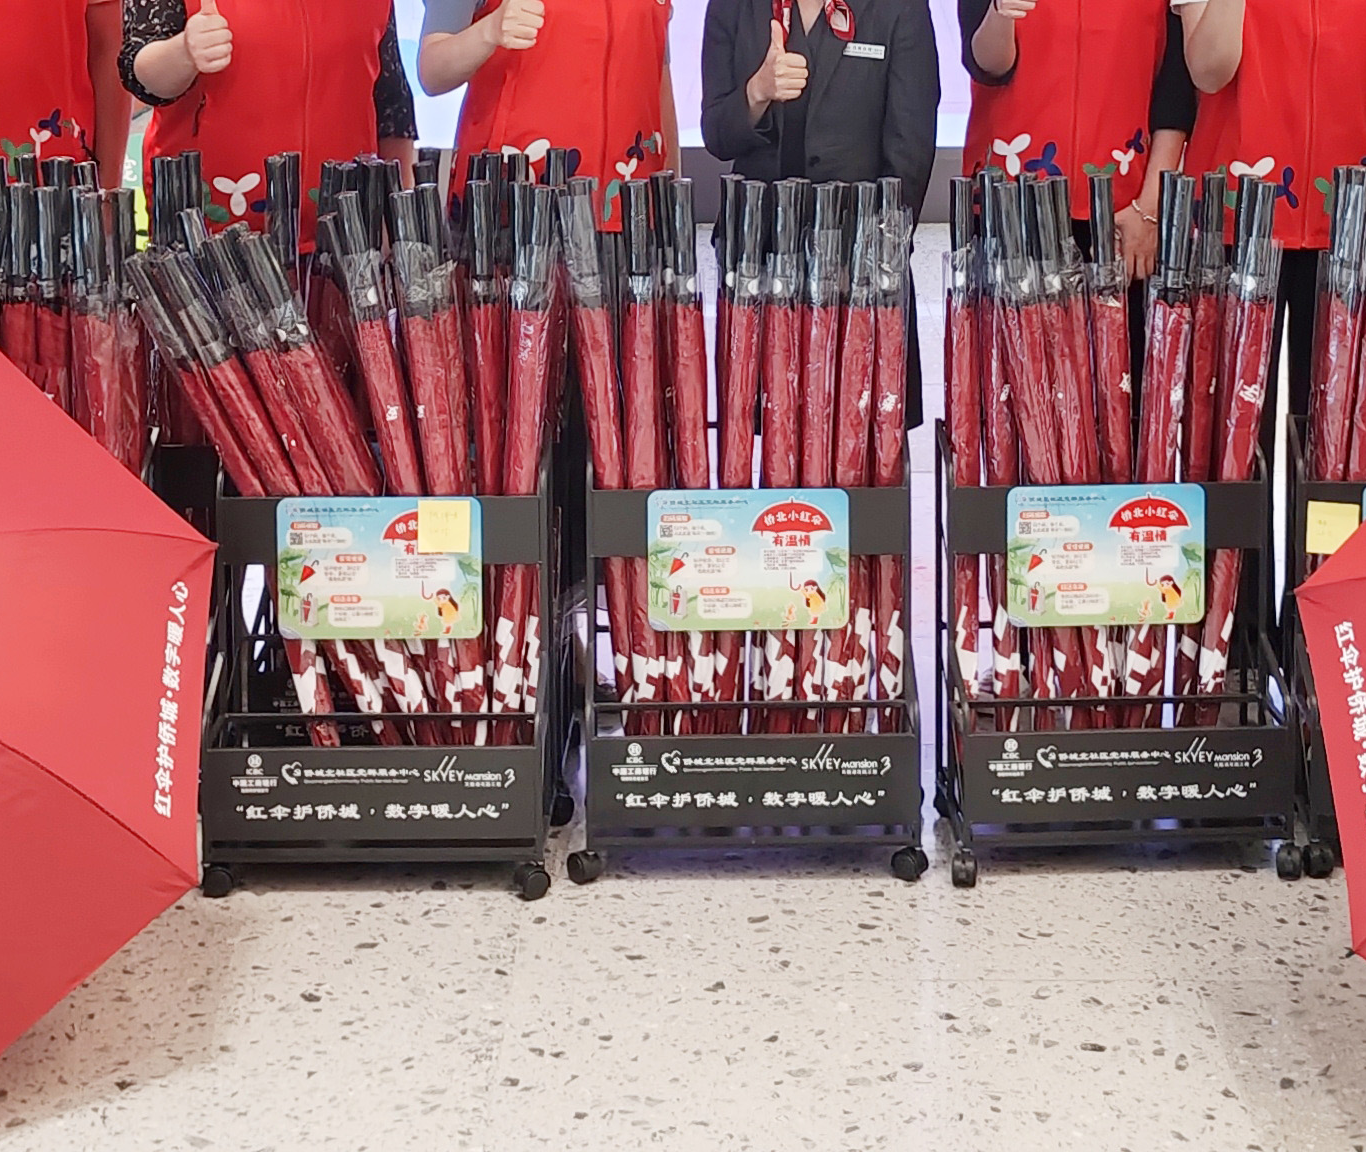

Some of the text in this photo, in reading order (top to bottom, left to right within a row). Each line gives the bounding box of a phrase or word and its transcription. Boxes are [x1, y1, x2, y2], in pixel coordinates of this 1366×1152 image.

[152, 580, 190, 819] 红伞护侨城·数字暖人心
